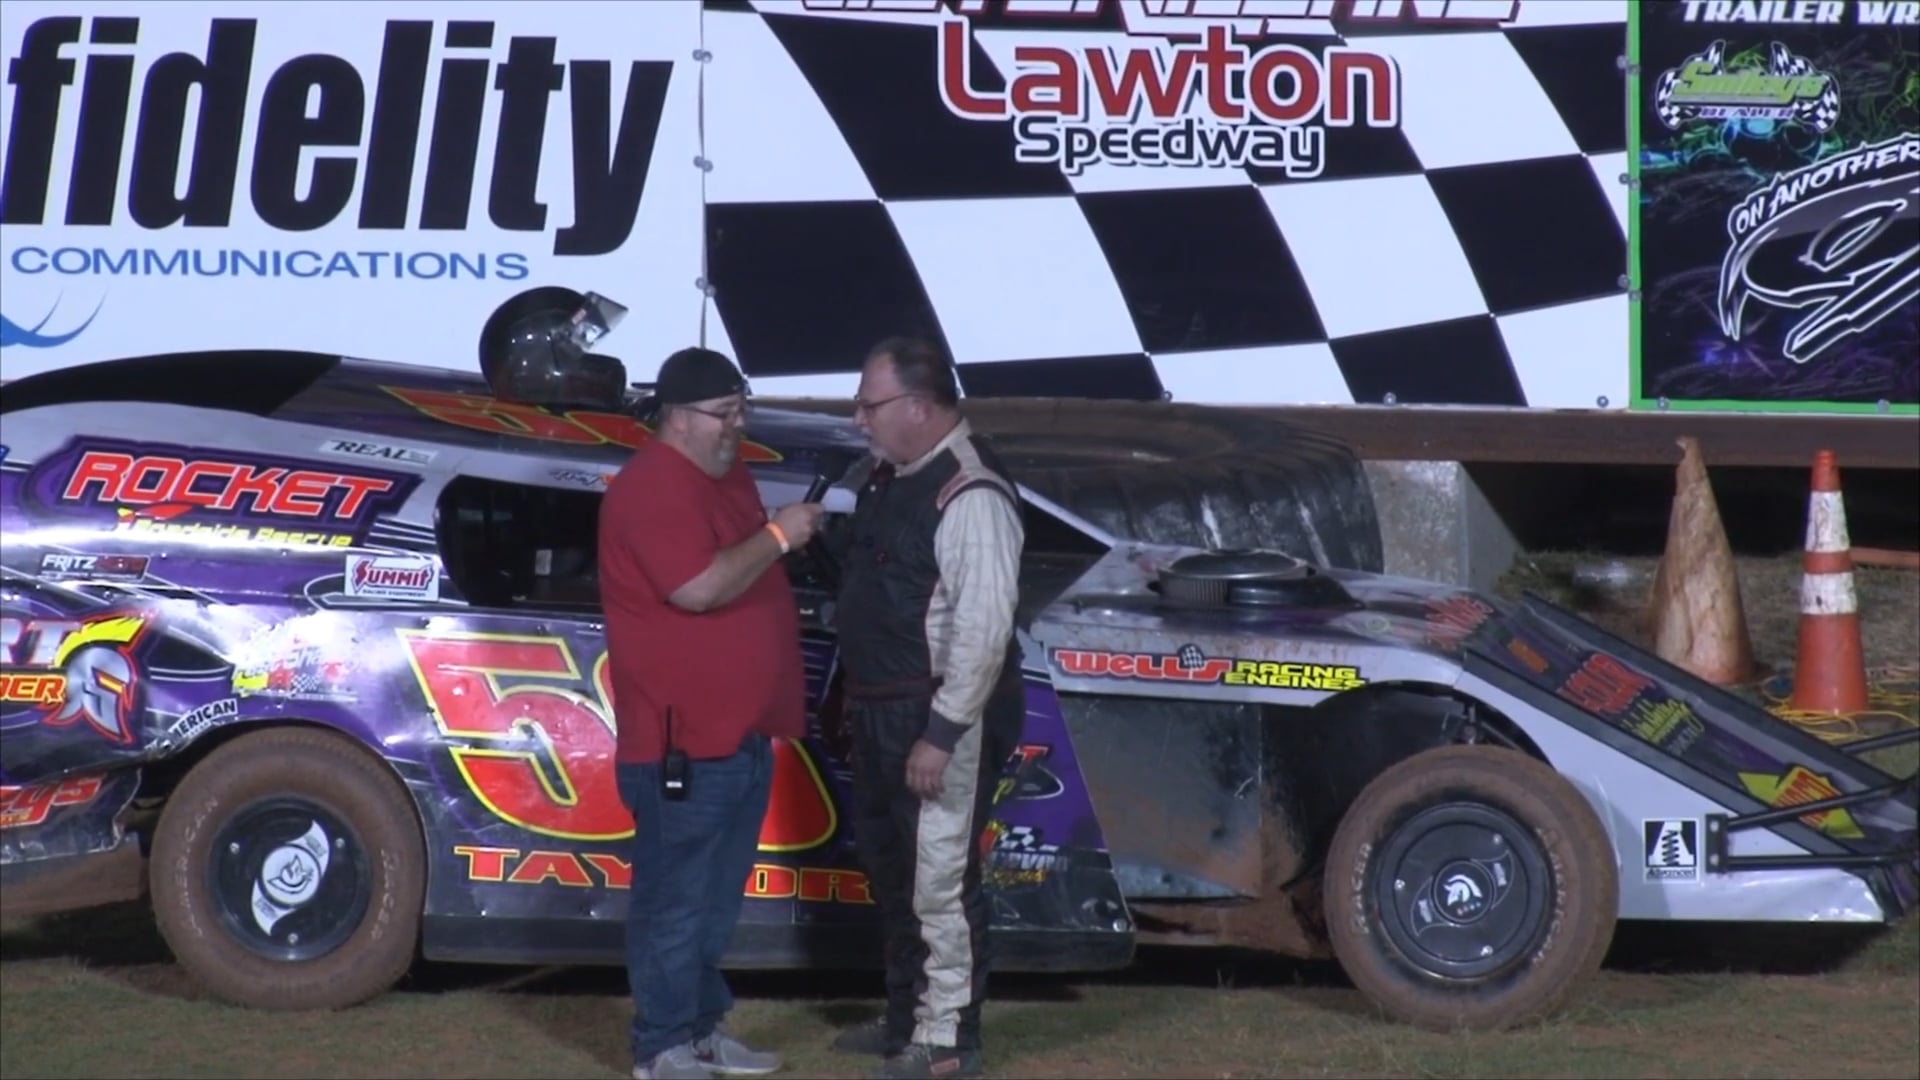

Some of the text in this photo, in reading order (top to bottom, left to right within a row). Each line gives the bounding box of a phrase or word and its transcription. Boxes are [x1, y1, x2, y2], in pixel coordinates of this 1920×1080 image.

[1681, 0, 1920, 24] TRAILER WR
[938, 16, 1398, 128] Lawton
[0, 15, 674, 256] fidelity
[1015, 116, 1324, 175] Speedway
[1736, 140, 1920, 234] ON ANOTHER
[11, 246, 530, 281] COMMUNICATIONS
[63, 450, 394, 520] ROCKET
[255, 529, 352, 548] Rescue
[42, 553, 98, 574] FRITZ
[1223, 672, 1367, 690] ENGINES
[1236, 661, 1358, 681] RACING
[453, 846, 876, 904] TAYOR
